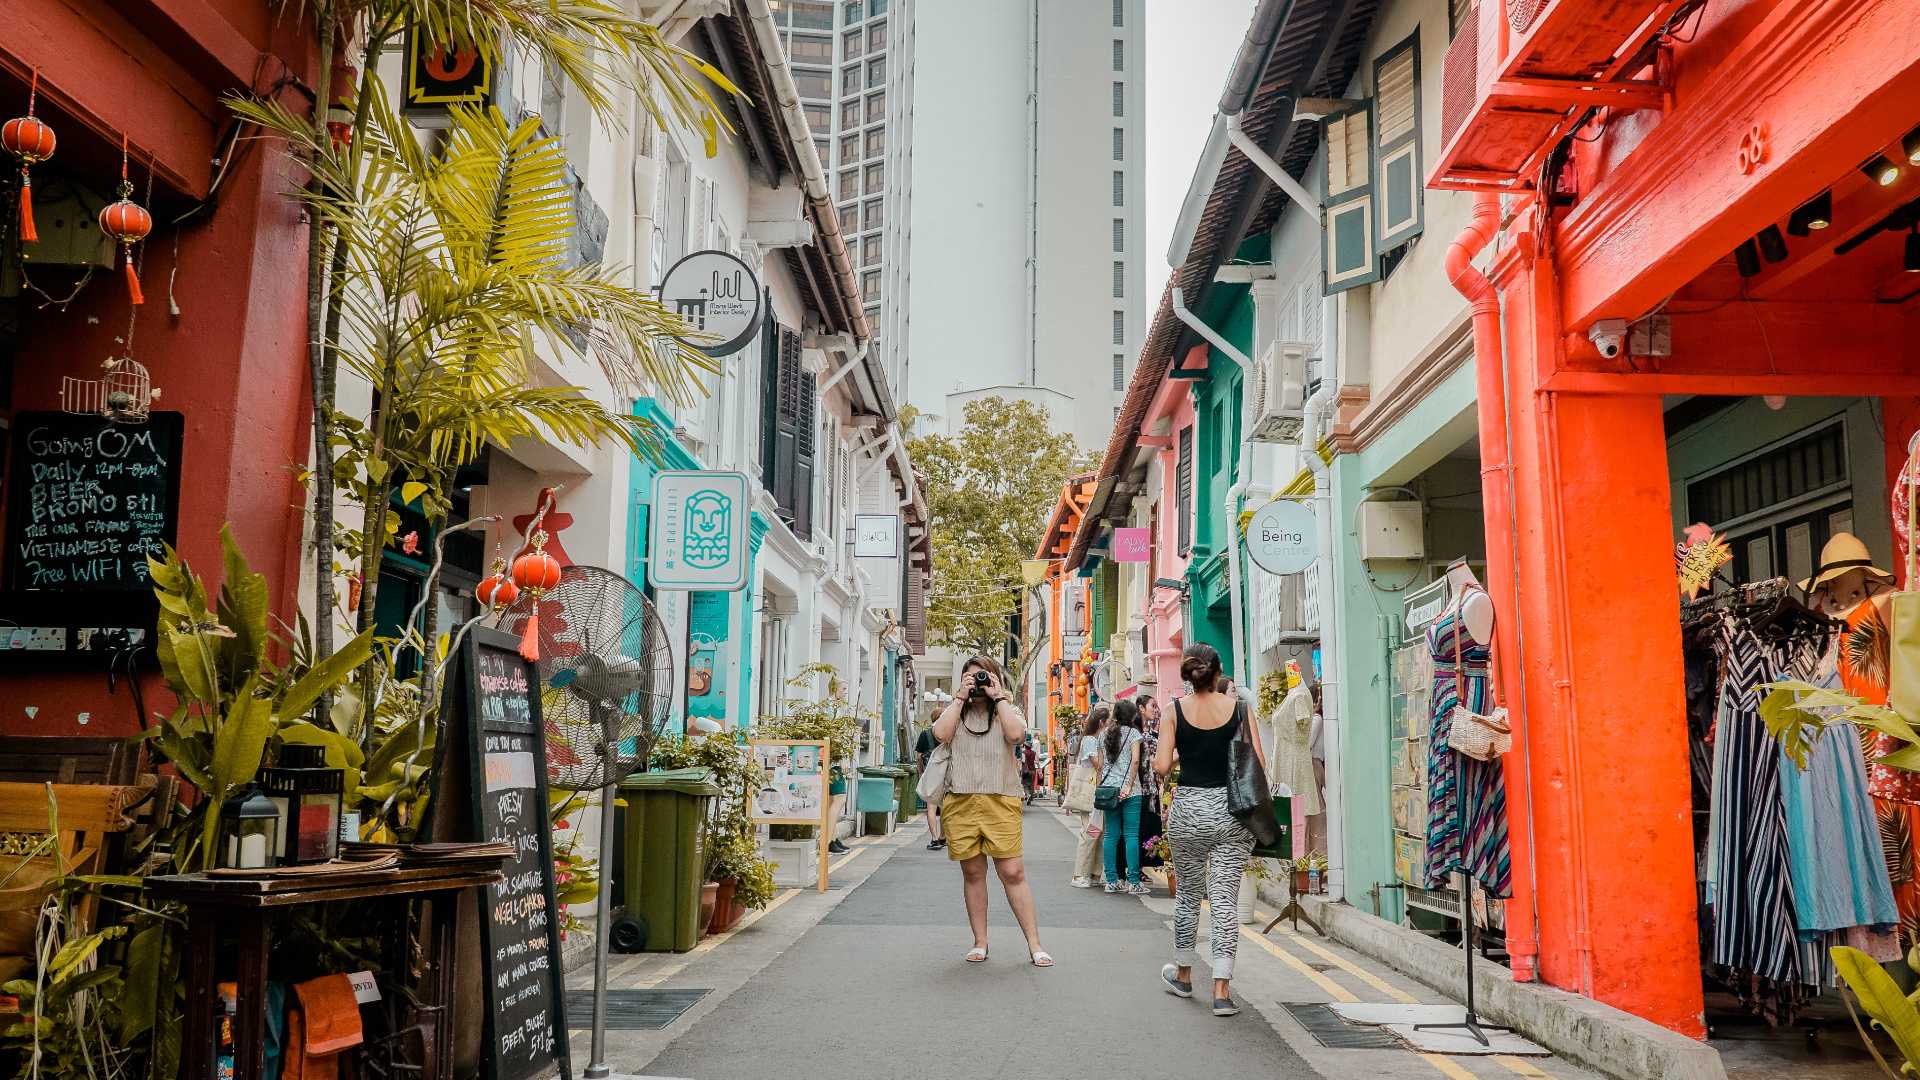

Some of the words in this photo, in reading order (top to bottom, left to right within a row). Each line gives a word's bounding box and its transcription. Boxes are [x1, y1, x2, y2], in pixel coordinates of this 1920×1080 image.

[1737, 125, 1761, 175] 68
[27, 427, 93, 458] Going
[97, 428, 167, 467] OM
[31, 460, 86, 483] Daily
[31, 480, 104, 507] BEER
[20, 538, 122, 559] VIETNAMESE
[1262, 529, 1302, 544] Being
[1262, 544, 1311, 556] Centre
[25, 560, 66, 585] Free
[72, 558, 121, 582] WIFI
[498, 791, 523, 821] FRESH
[519, 893, 546, 918] CHAKRA
[502, 1026, 525, 1055] BEER
[526, 1009, 545, 1032] BUCKET
